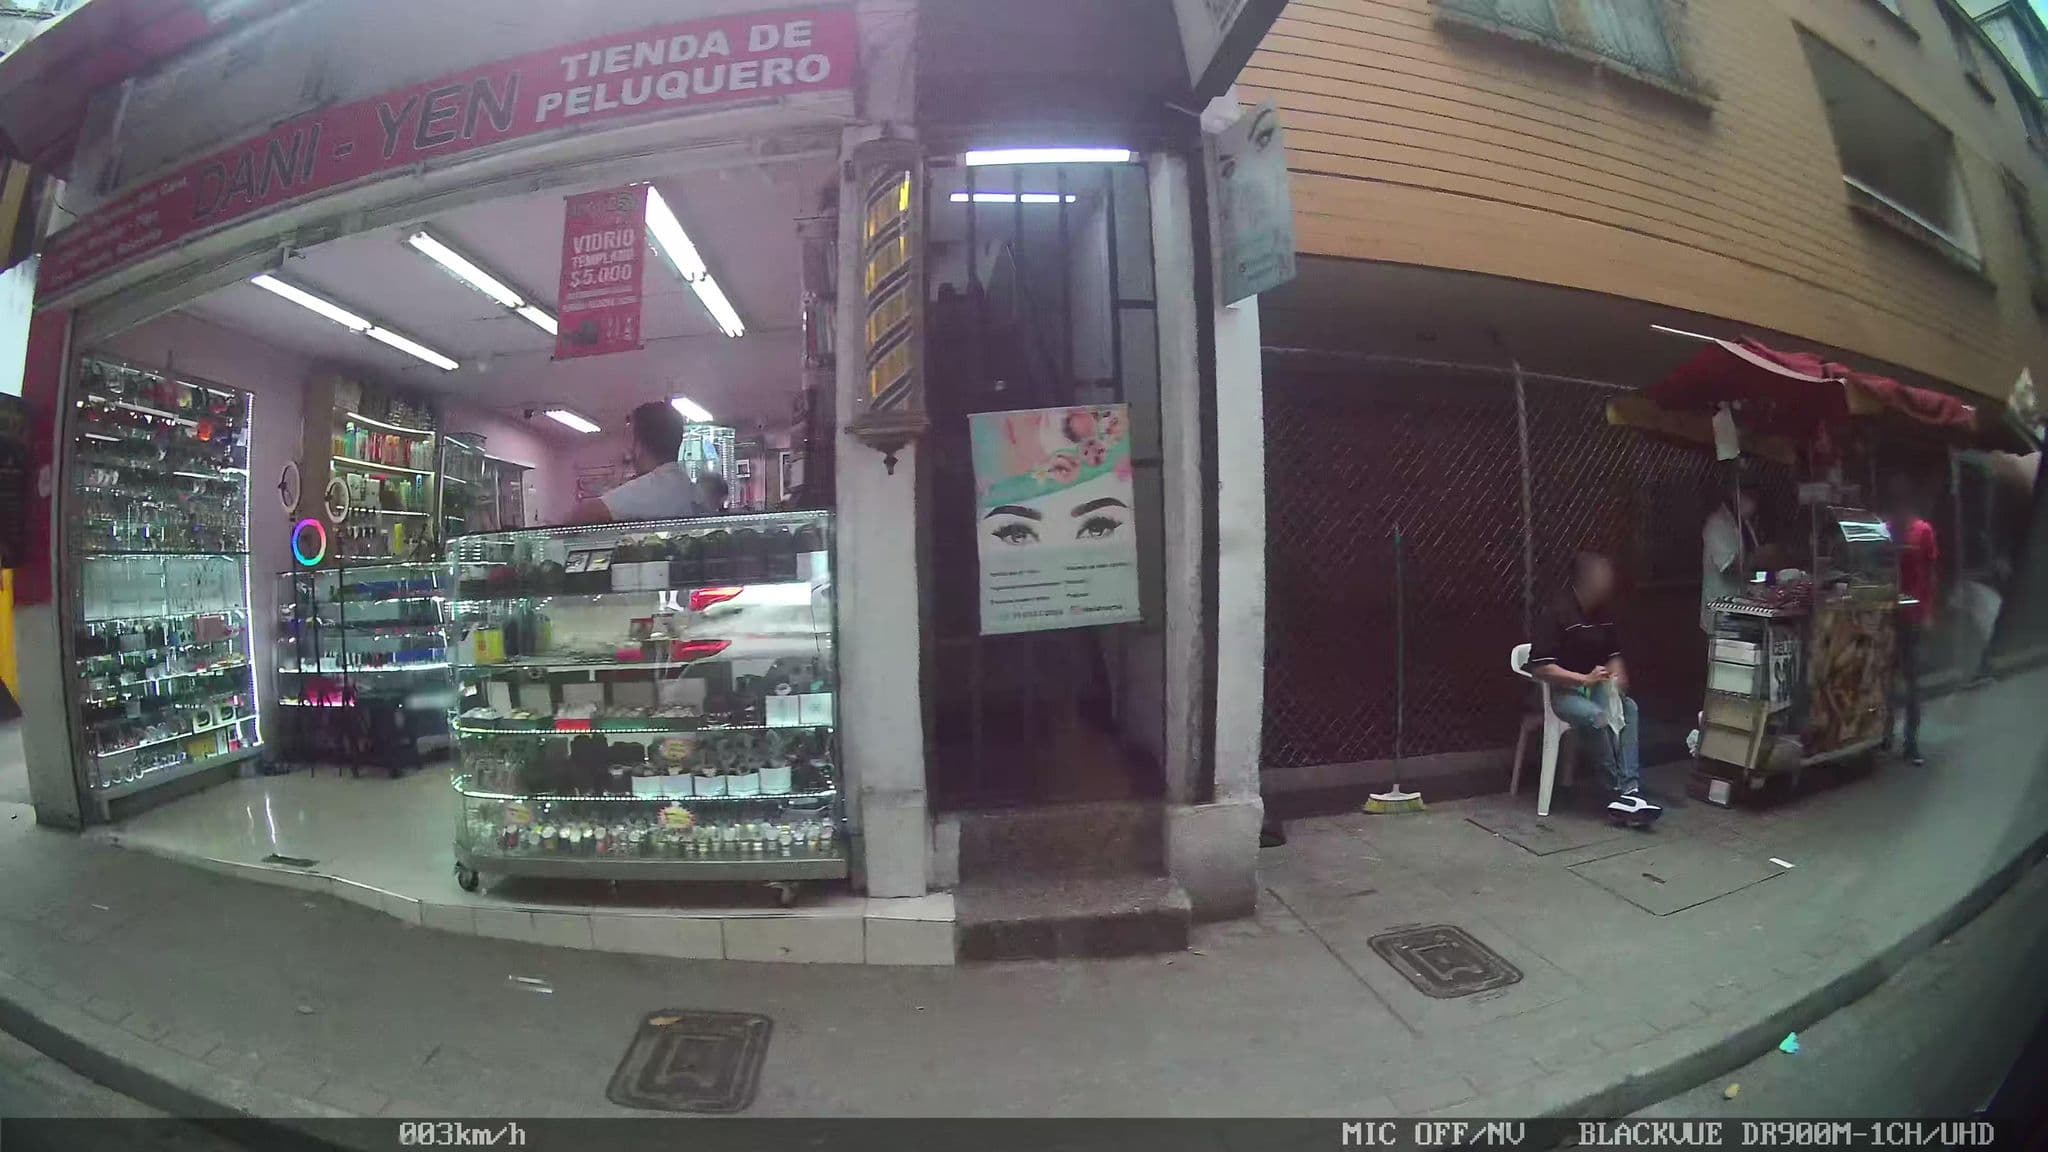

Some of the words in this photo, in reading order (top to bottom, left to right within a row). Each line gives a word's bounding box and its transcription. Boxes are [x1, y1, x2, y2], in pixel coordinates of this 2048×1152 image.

[560, 30, 731, 82] TIENDA
[748, 20, 813, 52] DE
[535, 54, 831, 123] PELUQUERO
[190, 121, 323, 221] DANI
[376, 71, 520, 160] YEN
[573, 228, 635, 254] VIDRIO
[569, 264, 632, 288] $5.000
